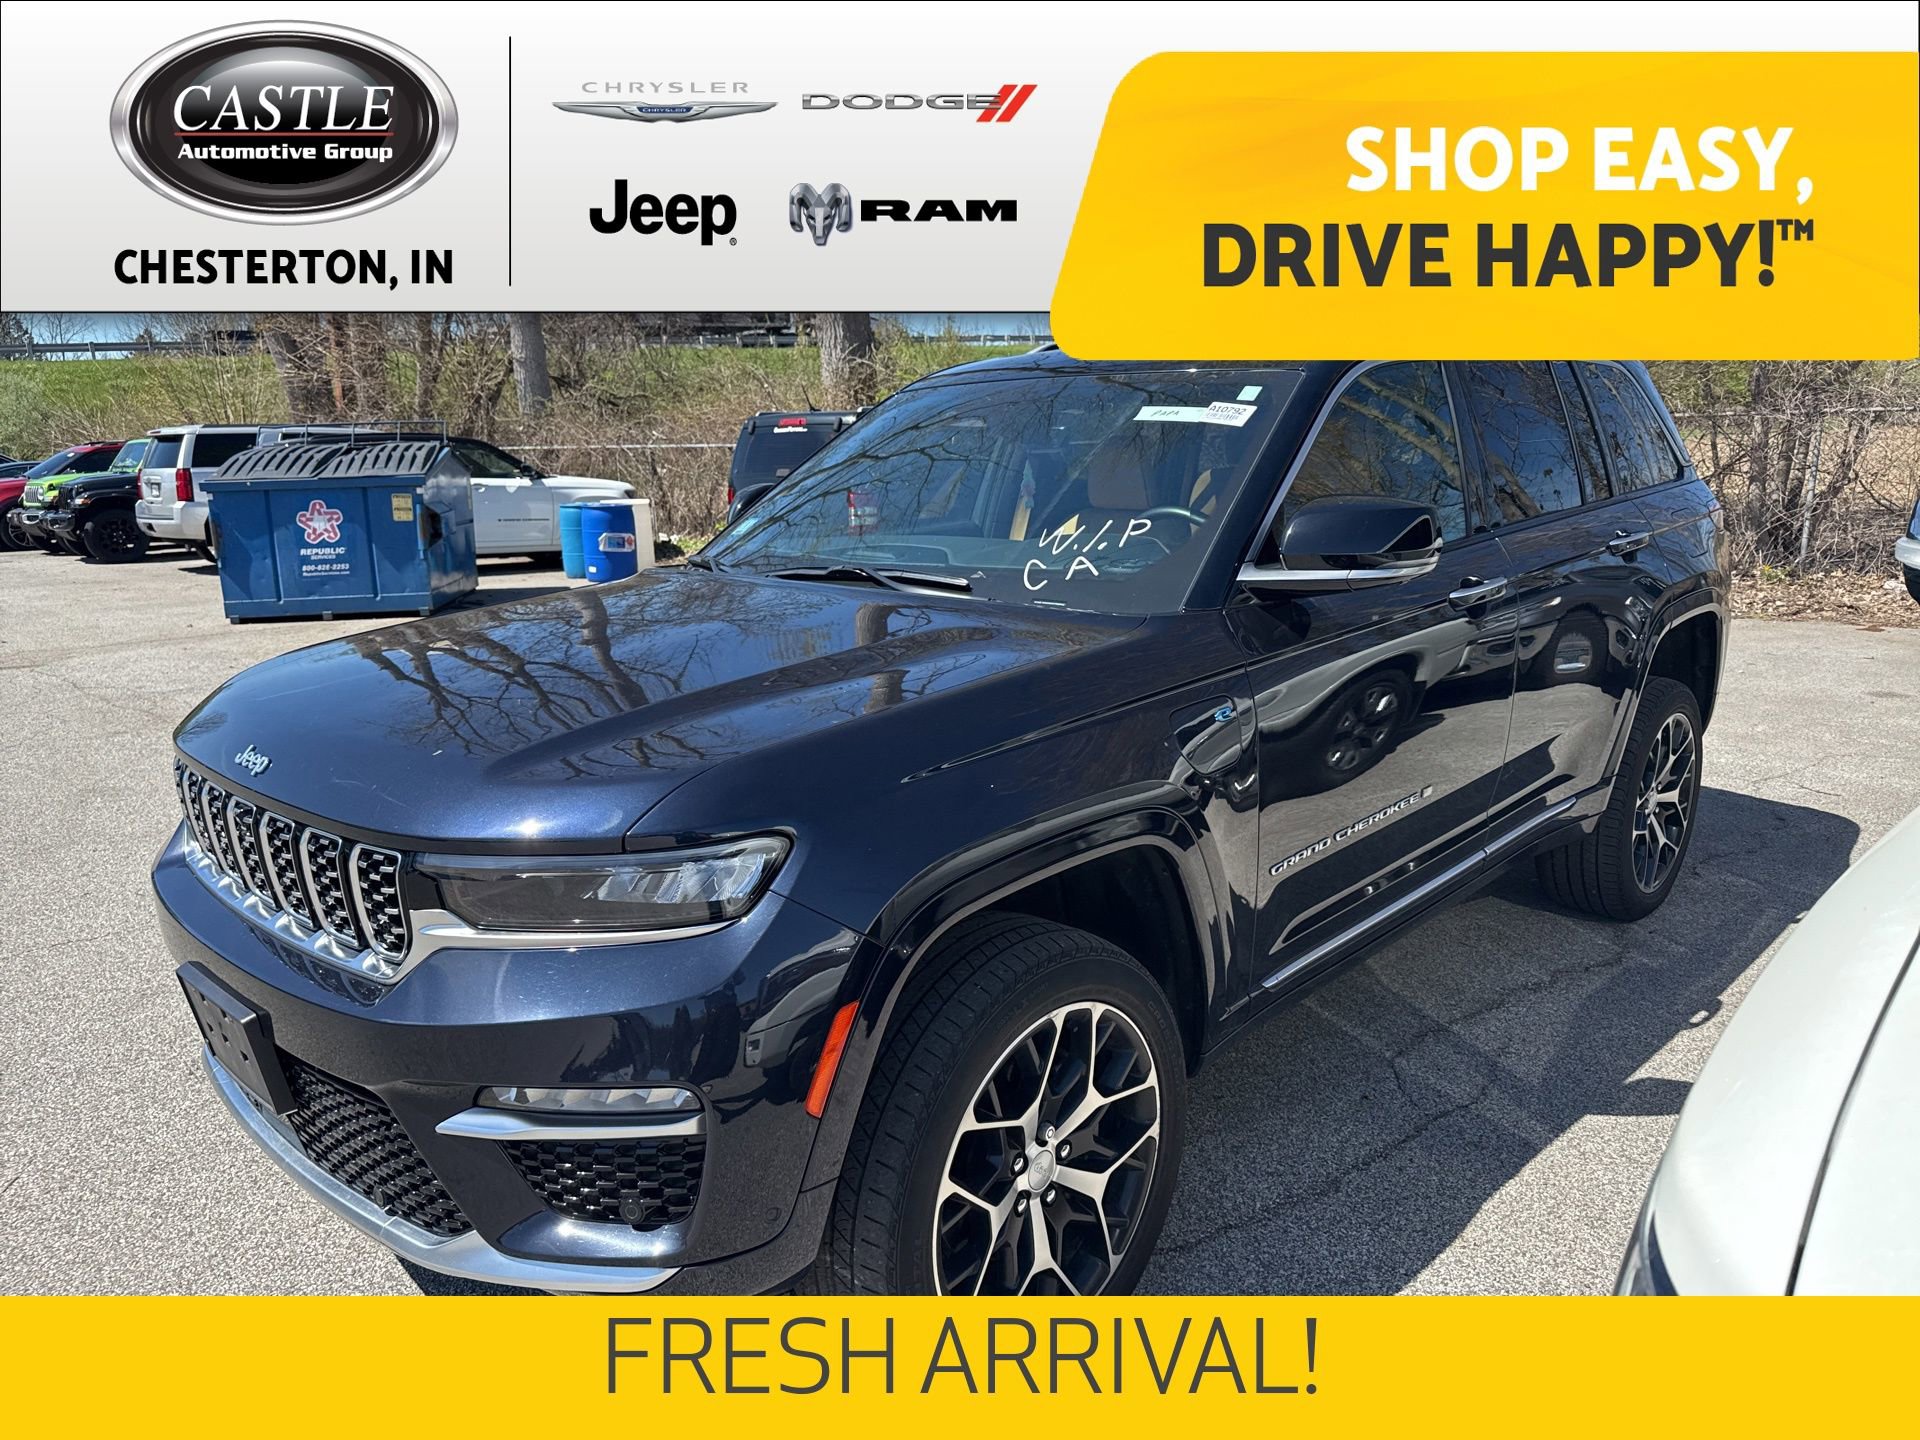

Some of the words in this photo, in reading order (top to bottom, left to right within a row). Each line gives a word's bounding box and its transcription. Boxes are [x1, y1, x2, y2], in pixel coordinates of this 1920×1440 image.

[1209, 405, 1248, 415] A10792
[300, 547, 346, 556] REPUBLIC
[234, 744, 271, 777] Jeep
[1269, 837, 1332, 877] GRAND
[1333, 792, 1420, 842] CHEROKEE
